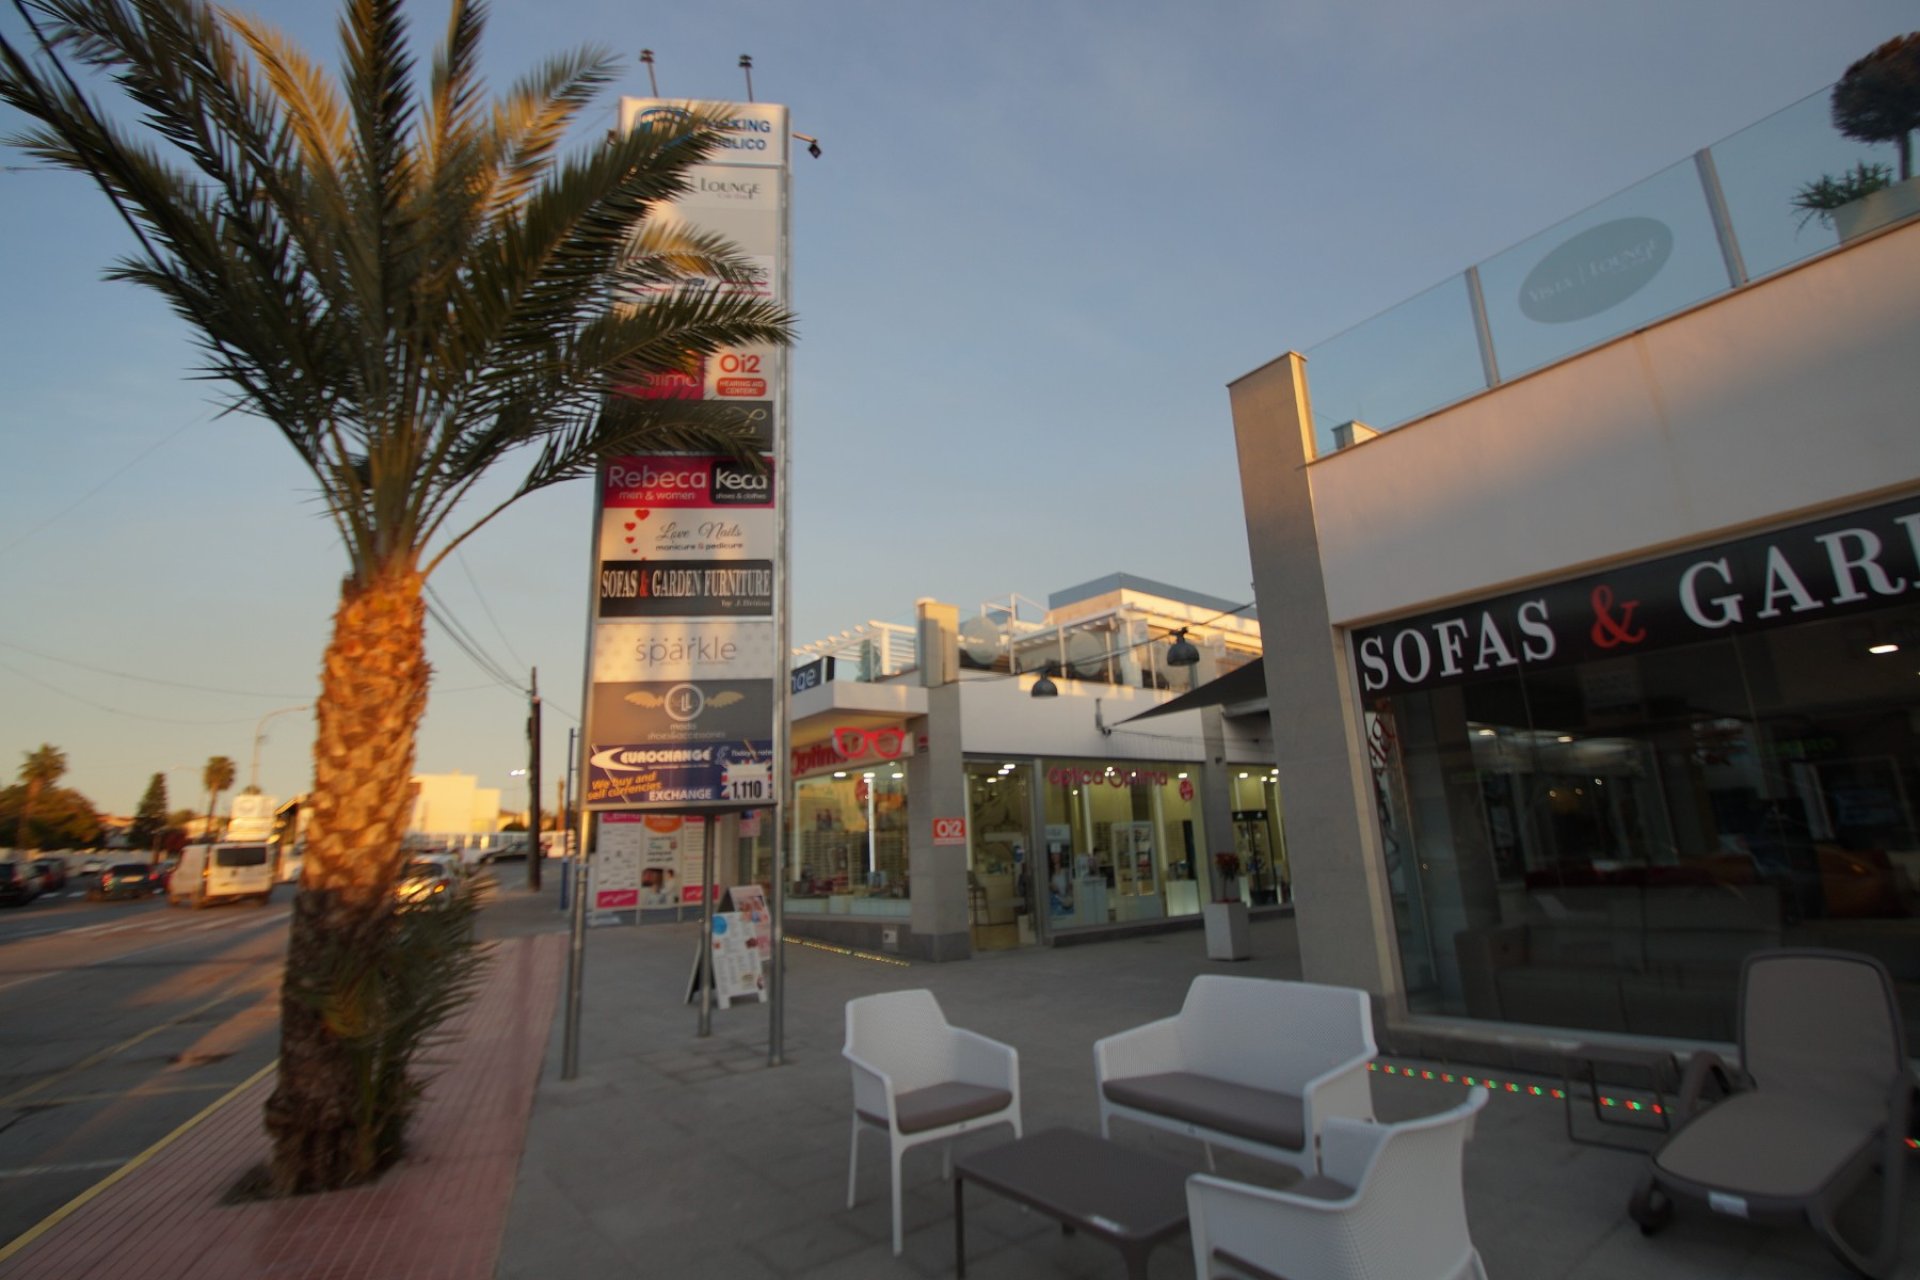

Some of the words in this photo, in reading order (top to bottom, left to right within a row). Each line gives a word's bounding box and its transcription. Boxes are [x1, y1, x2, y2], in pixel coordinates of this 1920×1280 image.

[719, 353, 761, 374] Oi2
[608, 465, 706, 489] Rebeca
[619, 490, 643, 500] men
[645, 489, 654, 500] &
[656, 490, 695, 500] women
[715, 492, 736, 500] shoes
[656, 521, 690, 543] Love
[698, 520, 743, 540] Nails
[655, 543, 696, 552] manicure
[705, 542, 744, 551] pedicure
[601, 570, 638, 598] SOFAS
[639, 569, 649, 597] &
[652, 568, 702, 598] GARDEN
[703, 568, 771, 597] FURNITURE
[1359, 599, 1557, 692] SOFAS
[1589, 583, 1647, 650] &
[1679, 511, 1920, 630] GAR
[635, 636, 737, 667] sparkle
[635, 770, 658, 783] and
[648, 788, 712, 801] EXCHANGE
